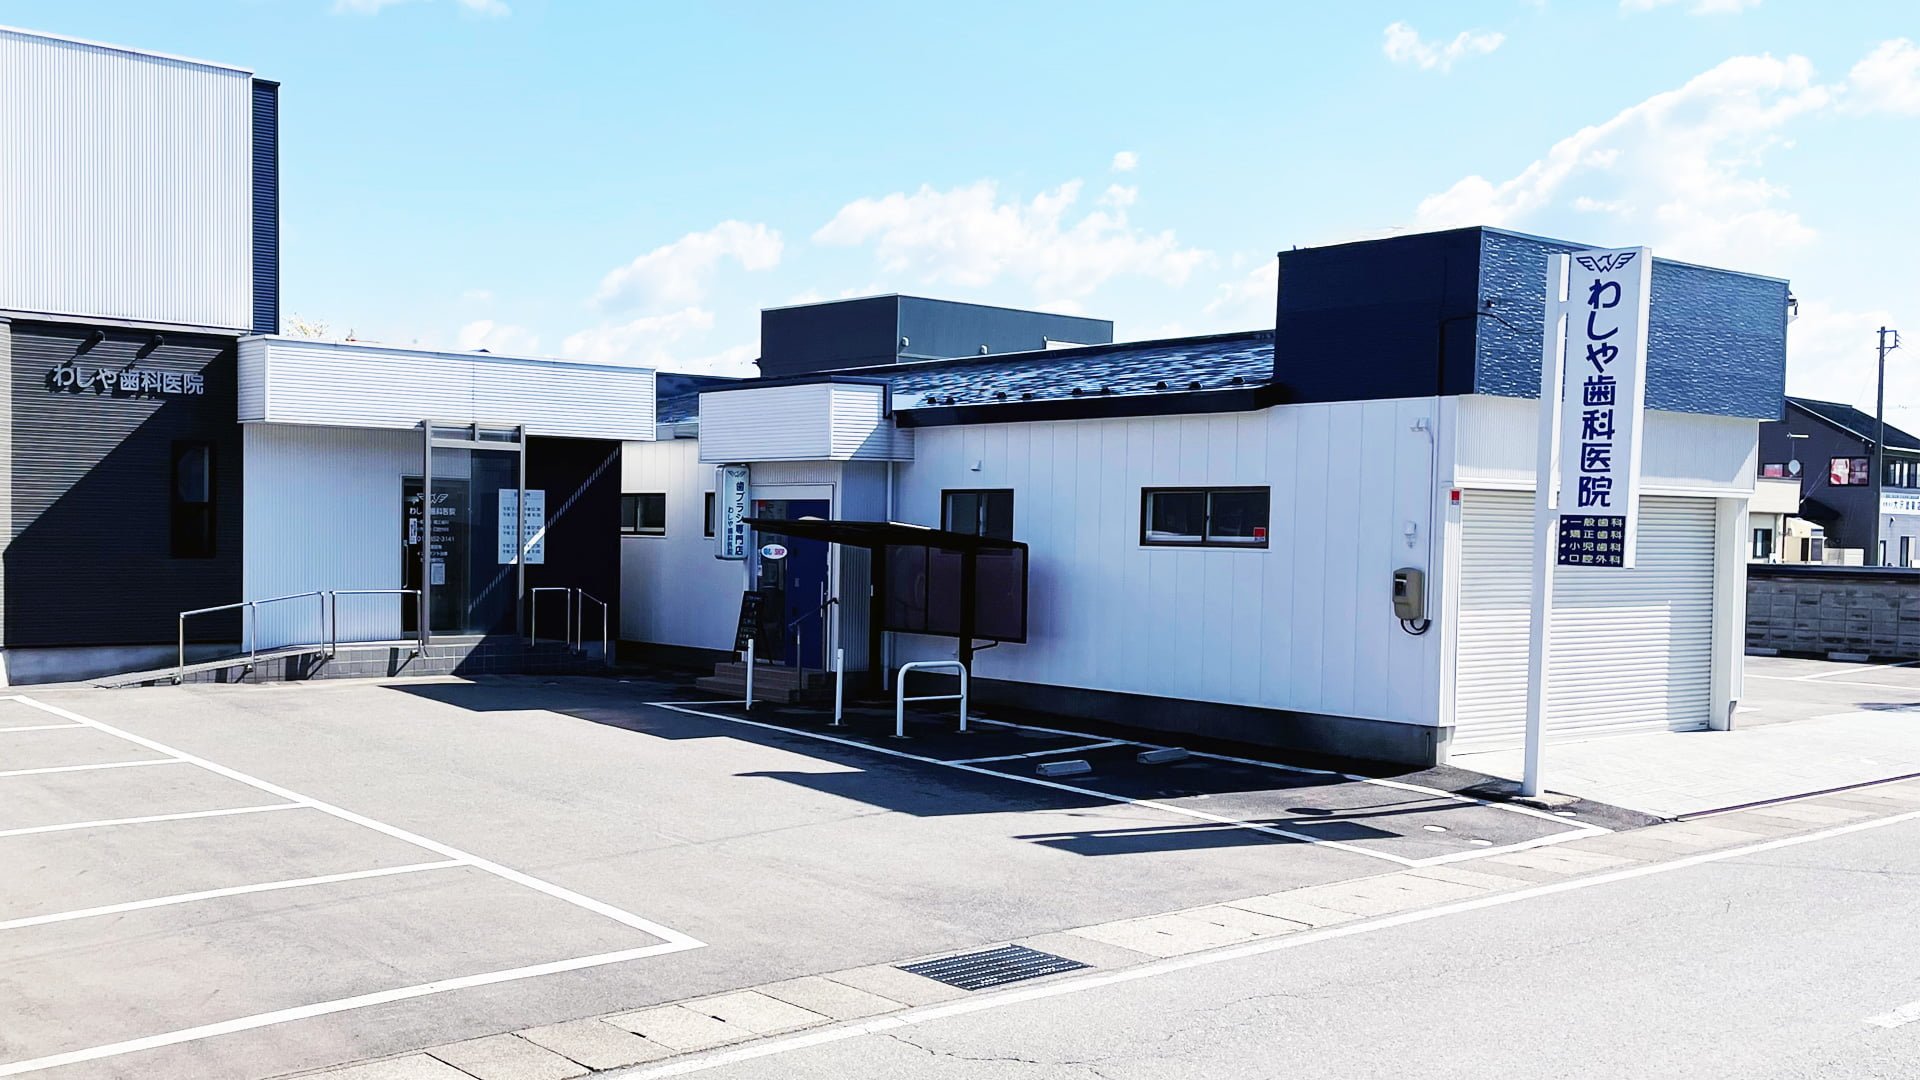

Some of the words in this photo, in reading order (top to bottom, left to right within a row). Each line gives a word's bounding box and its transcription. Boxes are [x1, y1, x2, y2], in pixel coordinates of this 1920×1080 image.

[53, 364, 204, 395] わしや歯科医院
[1577, 279, 1621, 508] わしや歯科医院
[1570, 517, 1623, 528] 一般歯科
[1569, 529, 1622, 540] 矯正歯科
[1569, 541, 1621, 552] 小児歯科
[1569, 553, 1620, 564] 口腔外科
